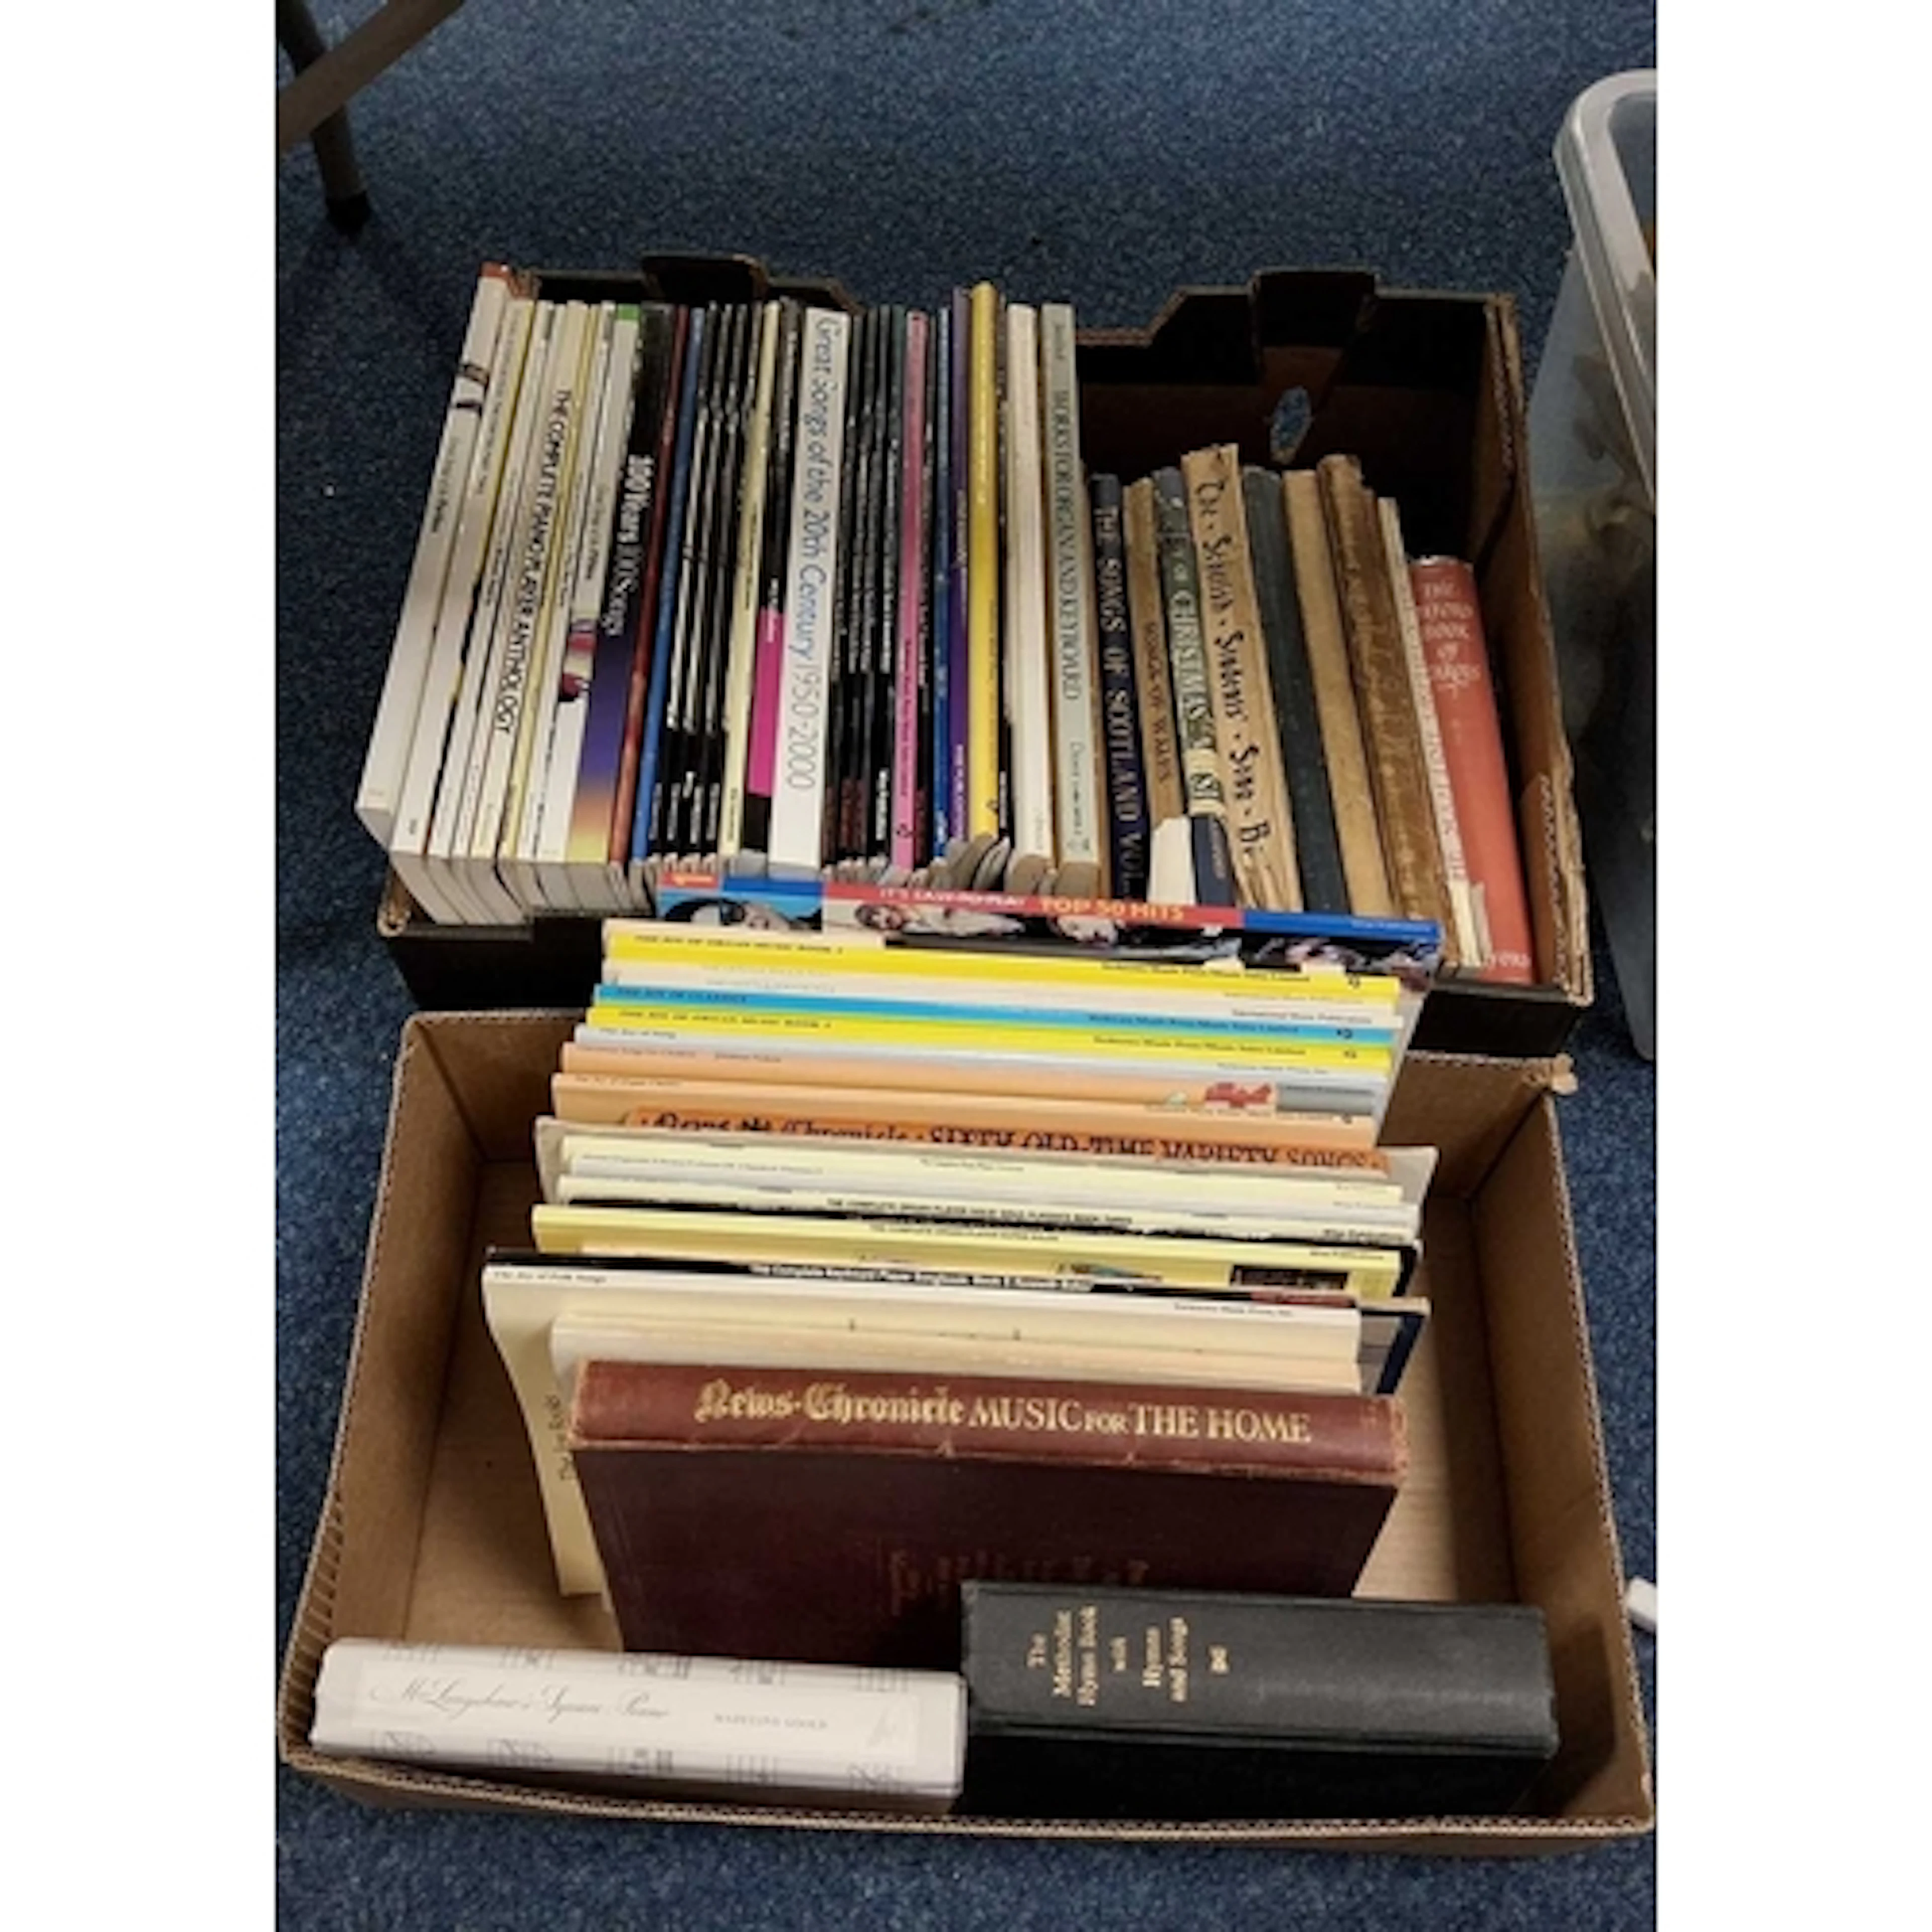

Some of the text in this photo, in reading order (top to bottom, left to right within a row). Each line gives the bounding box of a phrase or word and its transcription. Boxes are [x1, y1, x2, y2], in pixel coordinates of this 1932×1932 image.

[786, 318, 841, 790] Great Songs of the 20th Century 1950-2000
[1093, 506, 1118, 546] THE
[1097, 557, 1128, 633] SONGS
[495, 626, 533, 733] ANTHOLOGY
[1059, 596, 1083, 700] KEYBOARD
[1103, 649, 1131, 677] OF
[1170, 589, 1210, 719] CHRISTMAS
[1106, 688, 1140, 823] SCOTLAND
[1038, 896, 1090, 915] TOP
[1096, 899, 1126, 917] 50
[1131, 902, 1184, 921] HITS
[694, 1377, 1313, 1444] News-Chronicle MUSIC FOR THE HOME
[1026, 1632, 1048, 1670] The
[1076, 1605, 1099, 1707] Hymn Book
[1168, 1667, 1188, 1703] and
